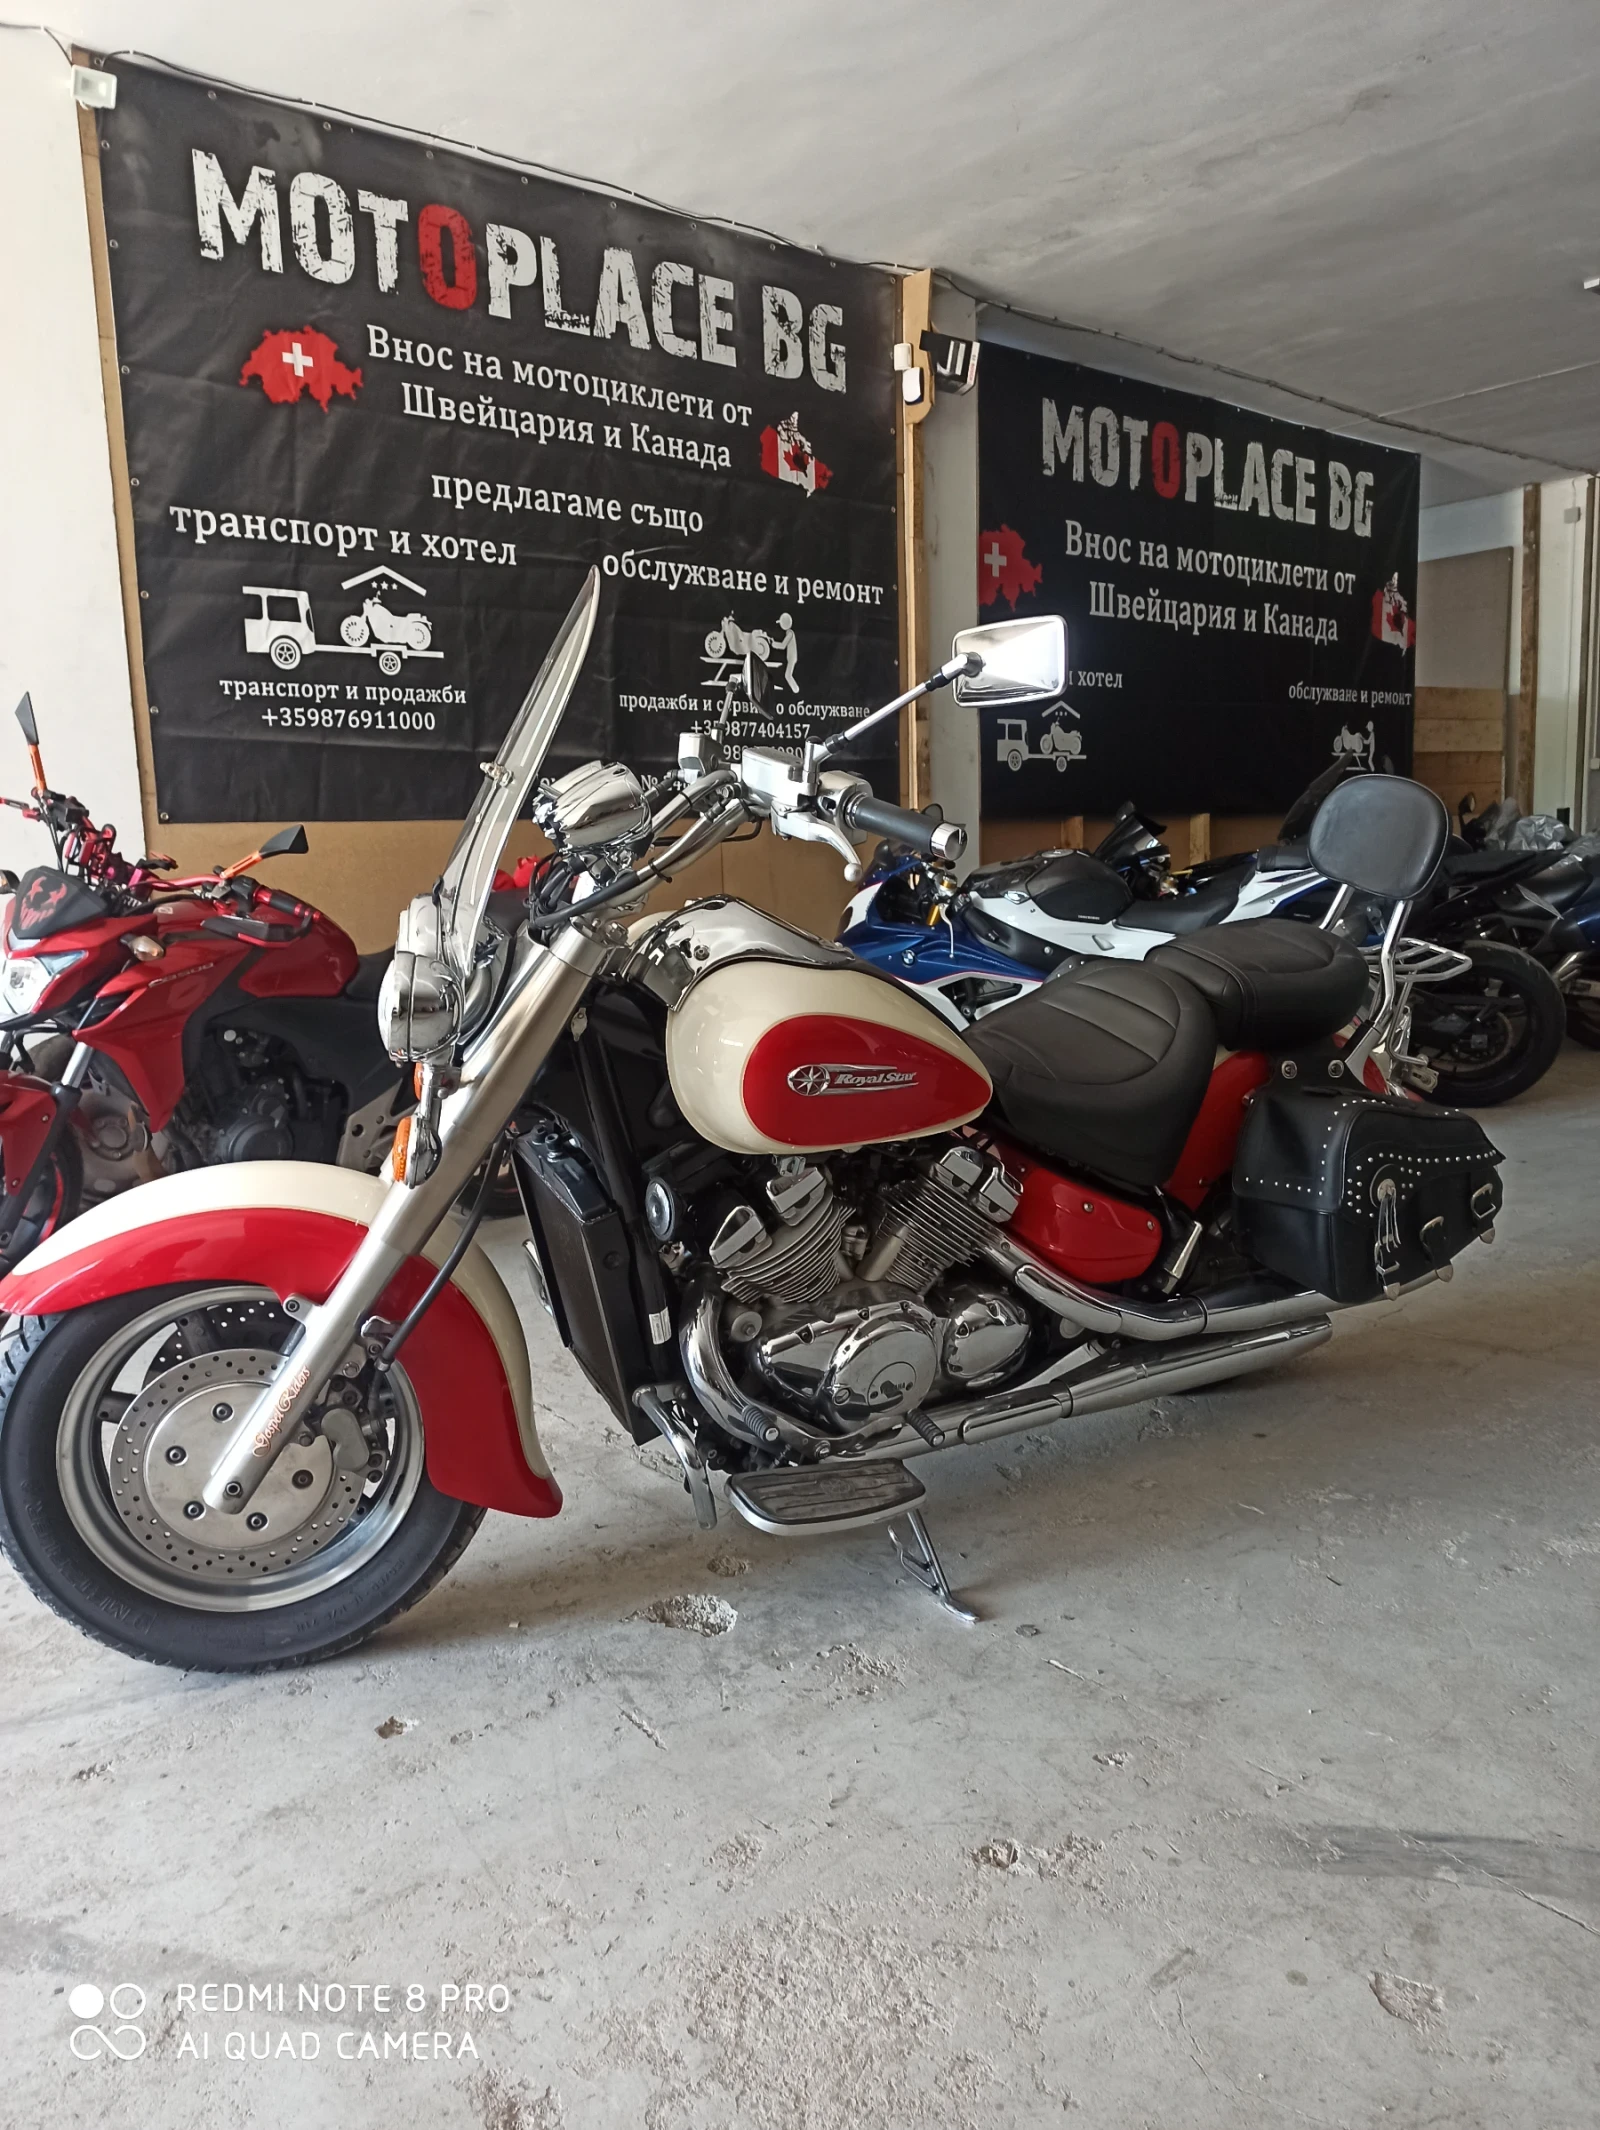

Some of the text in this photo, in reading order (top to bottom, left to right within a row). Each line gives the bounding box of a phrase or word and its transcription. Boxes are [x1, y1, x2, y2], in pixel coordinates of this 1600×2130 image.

[192, 149, 847, 394] MOTOPLACE BG
[366, 324, 752, 427] Внос на мотоциклети от
[401, 382, 732, 471] Швейцария и Канада
[1042, 397, 1374, 538] MOTOPLACE BG
[169, 505, 517, 566] транспорт и хотел
[431, 474, 704, 536] предлагаме също
[602, 549, 884, 605] обслужване и ремонт
[1065, 519, 1356, 595] Внос на мотоциклети от
[1089, 581, 1338, 645] Швейцария и Канада
[219, 679, 466, 705] транспорт и продажби
[619, 694, 698, 712] продажби
[703, 699, 712, 711] и
[788, 700, 870, 720] обслужване
[1077, 671, 1123, 688] хотел
[1288, 681, 1412, 708] обслужване и ремонт
[262, 707, 436, 730] +359876911000
